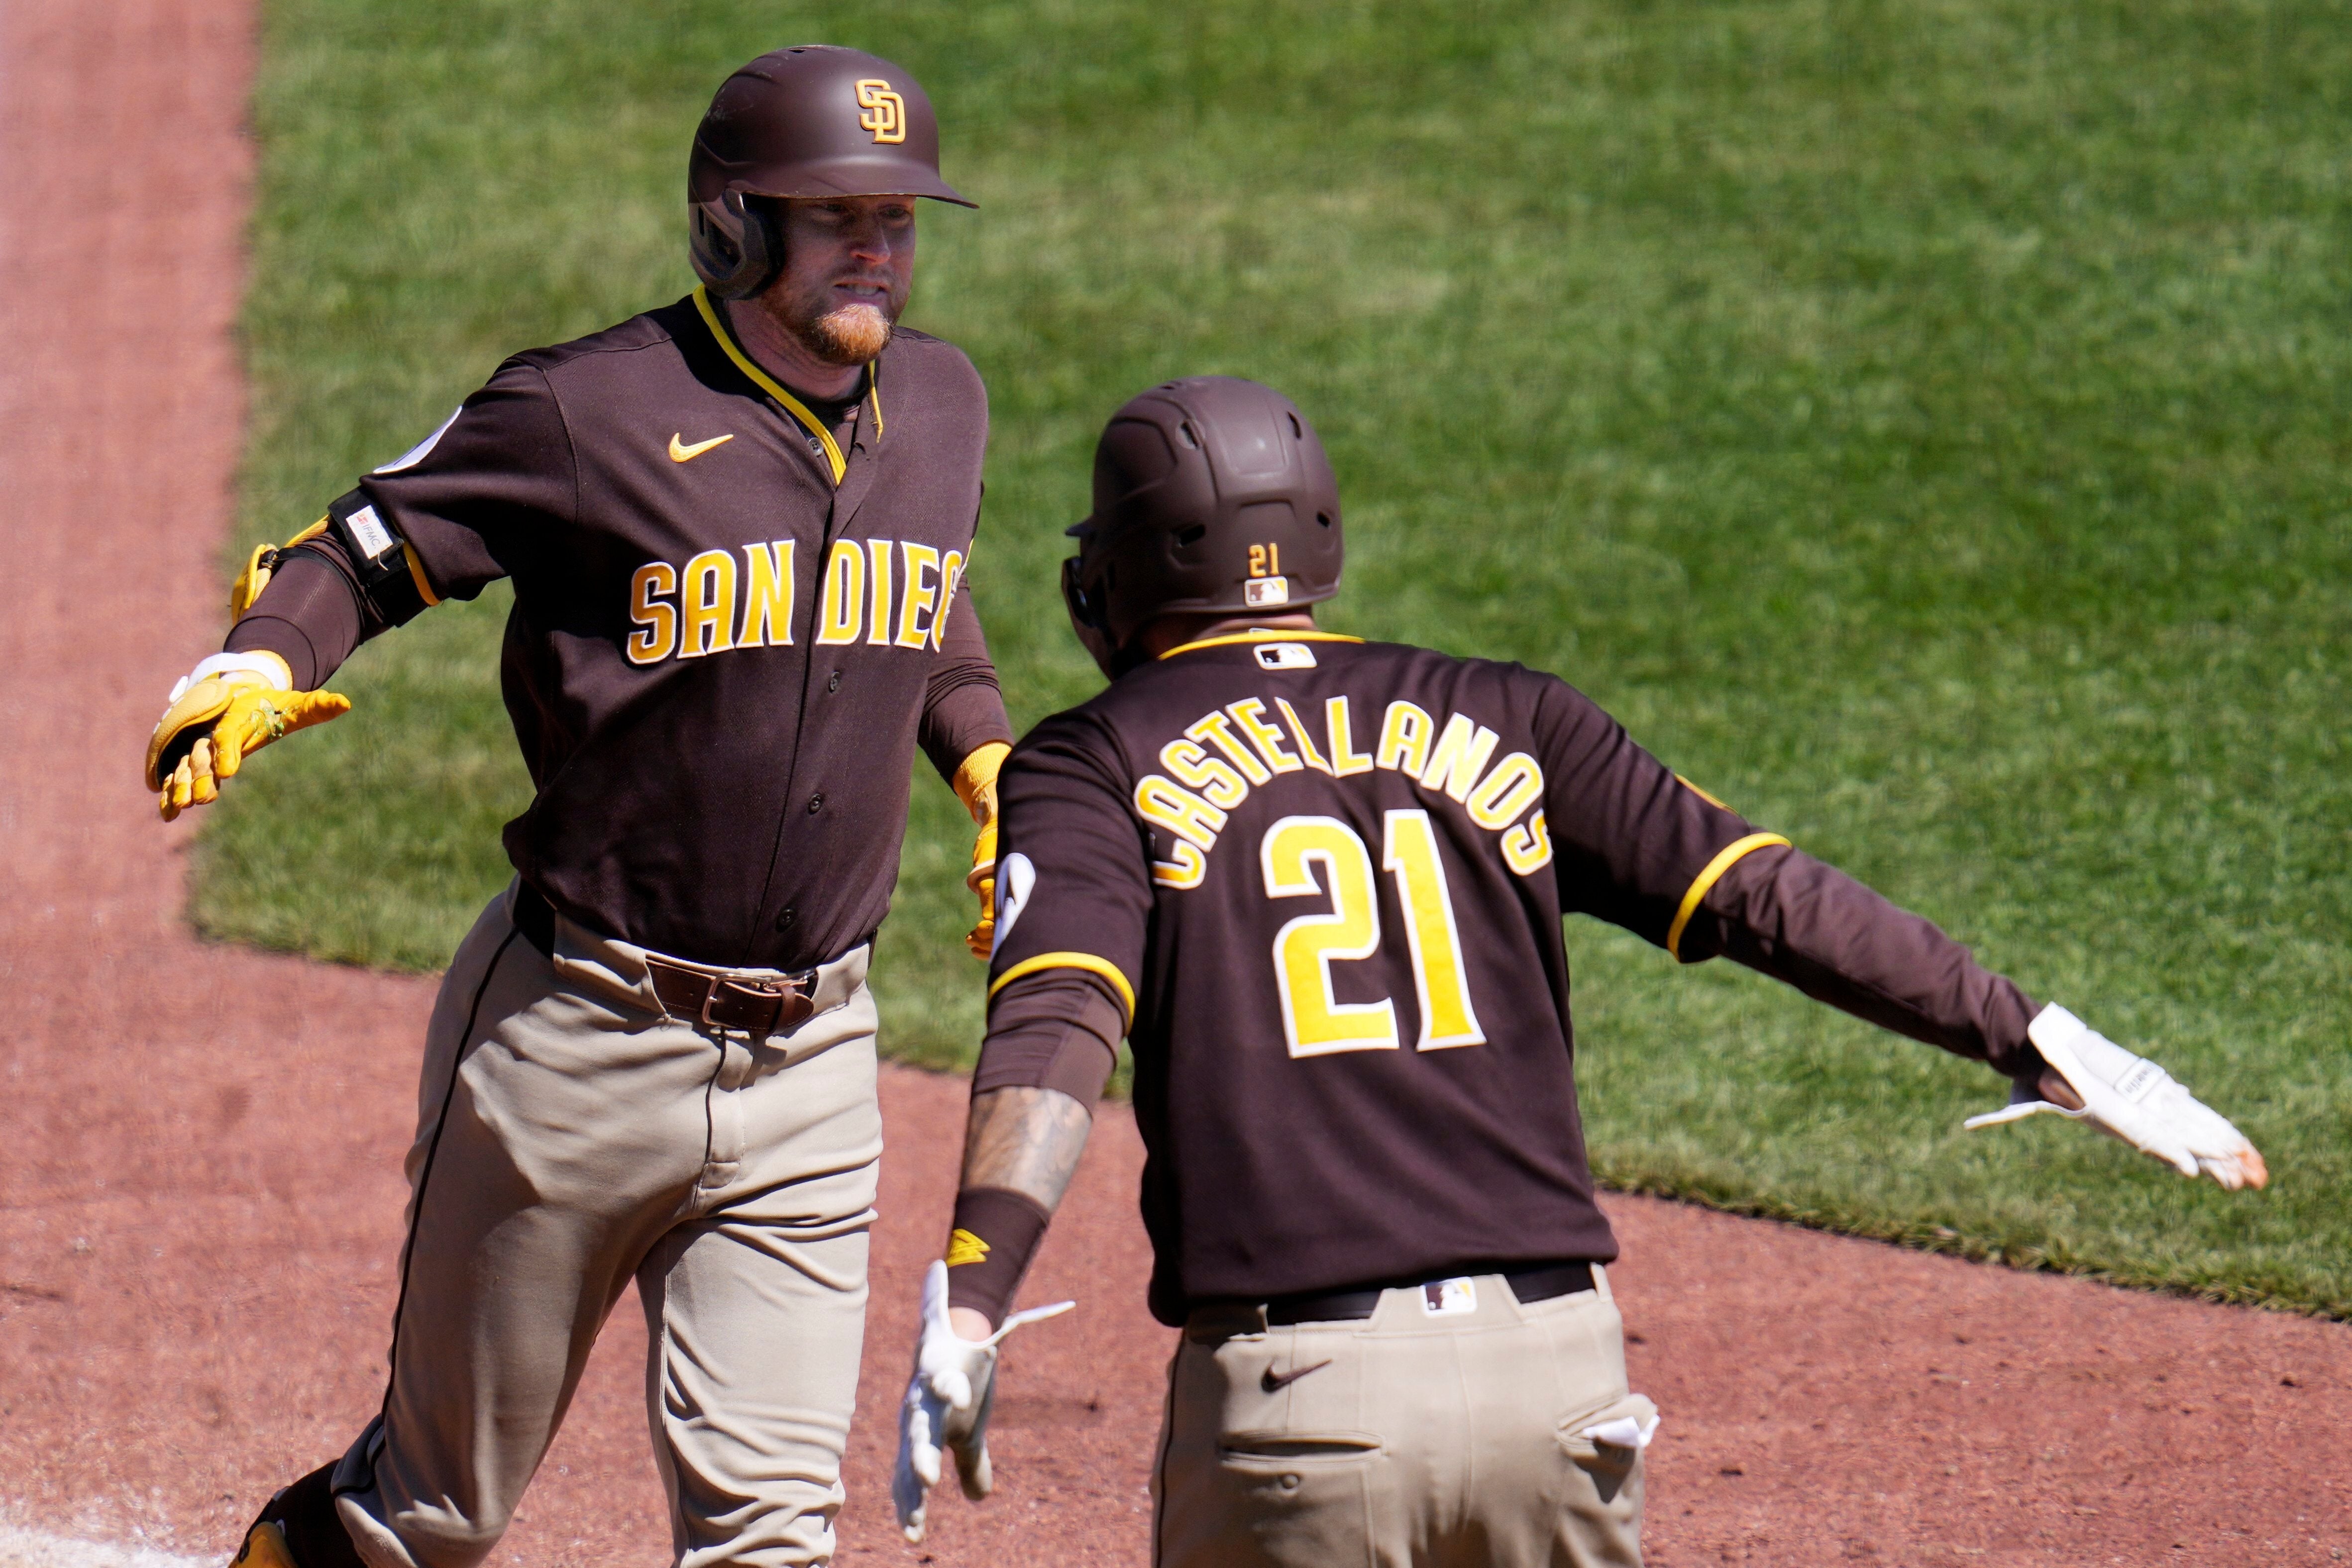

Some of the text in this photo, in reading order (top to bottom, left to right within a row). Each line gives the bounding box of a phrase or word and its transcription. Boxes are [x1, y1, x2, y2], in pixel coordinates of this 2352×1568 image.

[855, 79, 906, 144] SD
[627, 538, 795, 664] SAN
[1248, 542, 1280, 578] 21
[1134, 695, 1553, 890] CASTELLANOS
[1260, 809, 1487, 1058] 21
